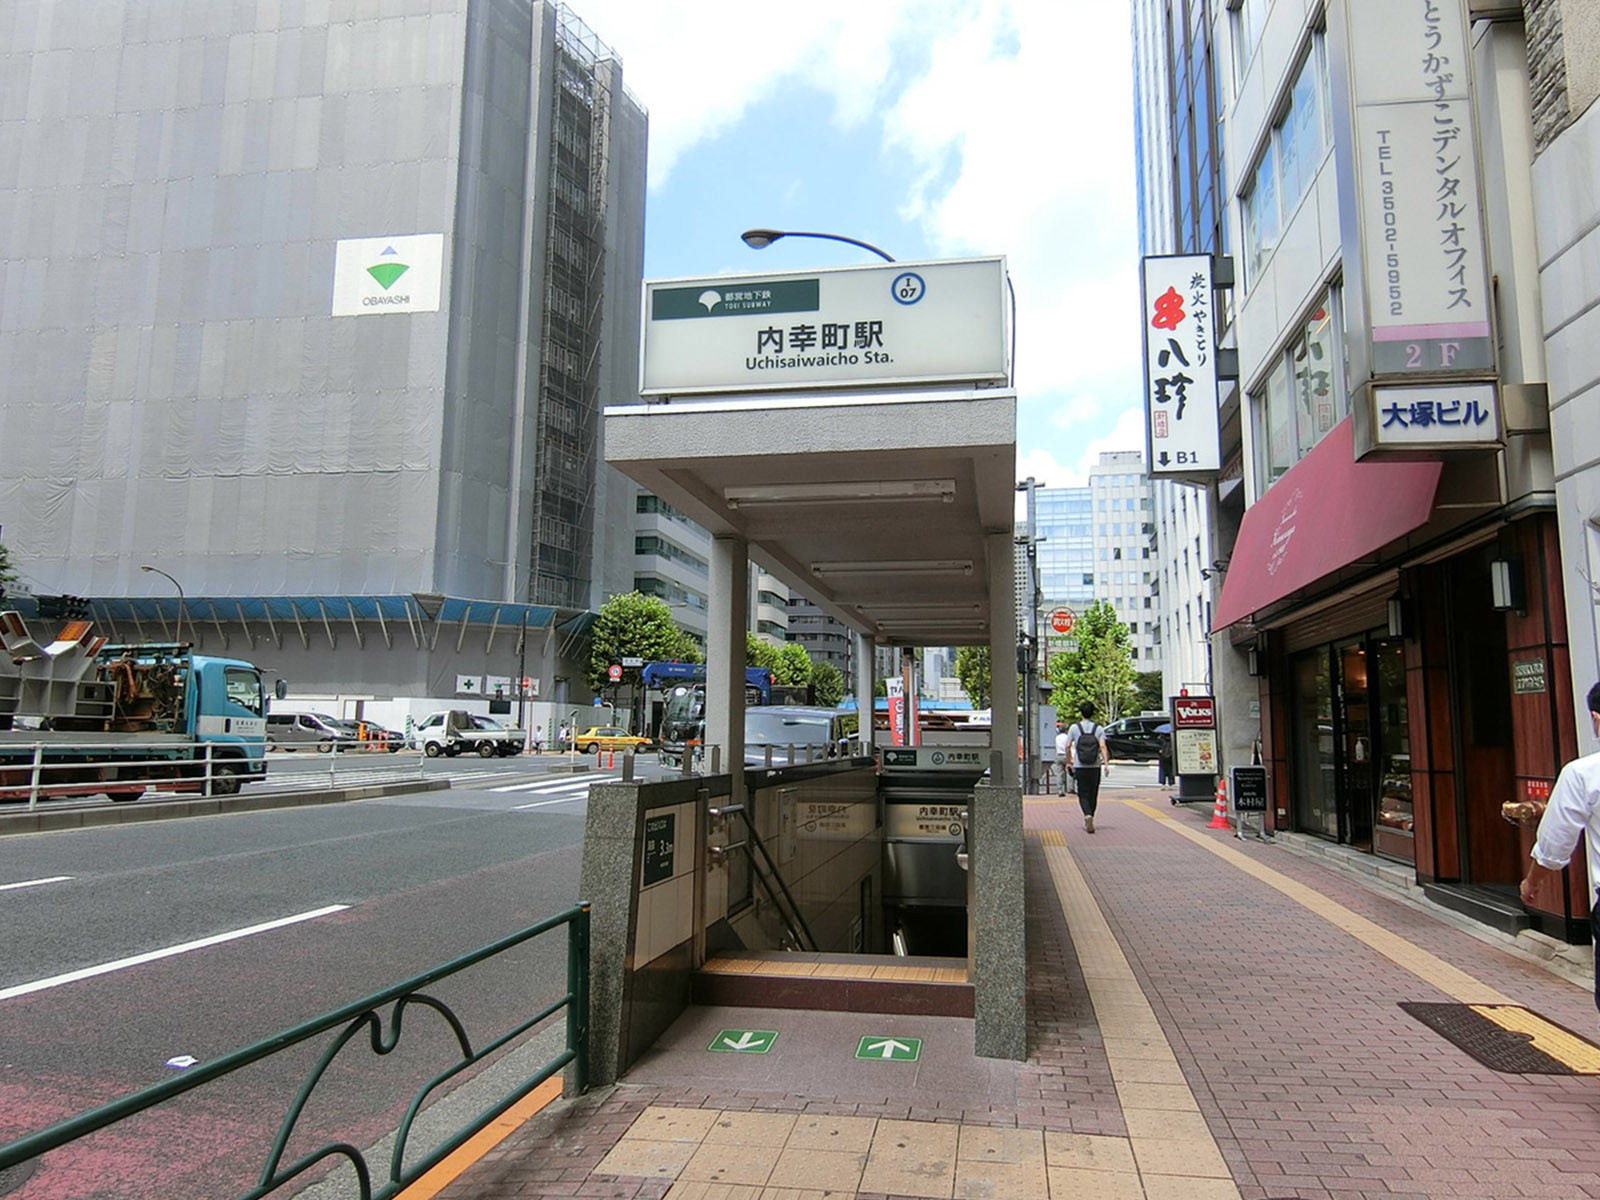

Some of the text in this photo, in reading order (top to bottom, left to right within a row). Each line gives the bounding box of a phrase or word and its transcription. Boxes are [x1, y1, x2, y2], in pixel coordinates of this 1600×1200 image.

[1376, 130, 1403, 316] TEL 3502-5952
[900, 287, 917, 299] 07
[362, 295, 410, 306] OBAYASHI
[742, 301, 772, 310] SUBWAY
[1189, 272, 1207, 367] 炭火やきとり
[757, 320, 884, 354] 内幸町駅
[745, 350, 895, 370] Uchisaiwaicho Sta.
[1381, 401, 1490, 429] 大塚ビル
[1176, 451, 1199, 464] B1
[948, 752, 980, 761] 内幸町駅
[919, 806, 959, 817] 内幸町駅
